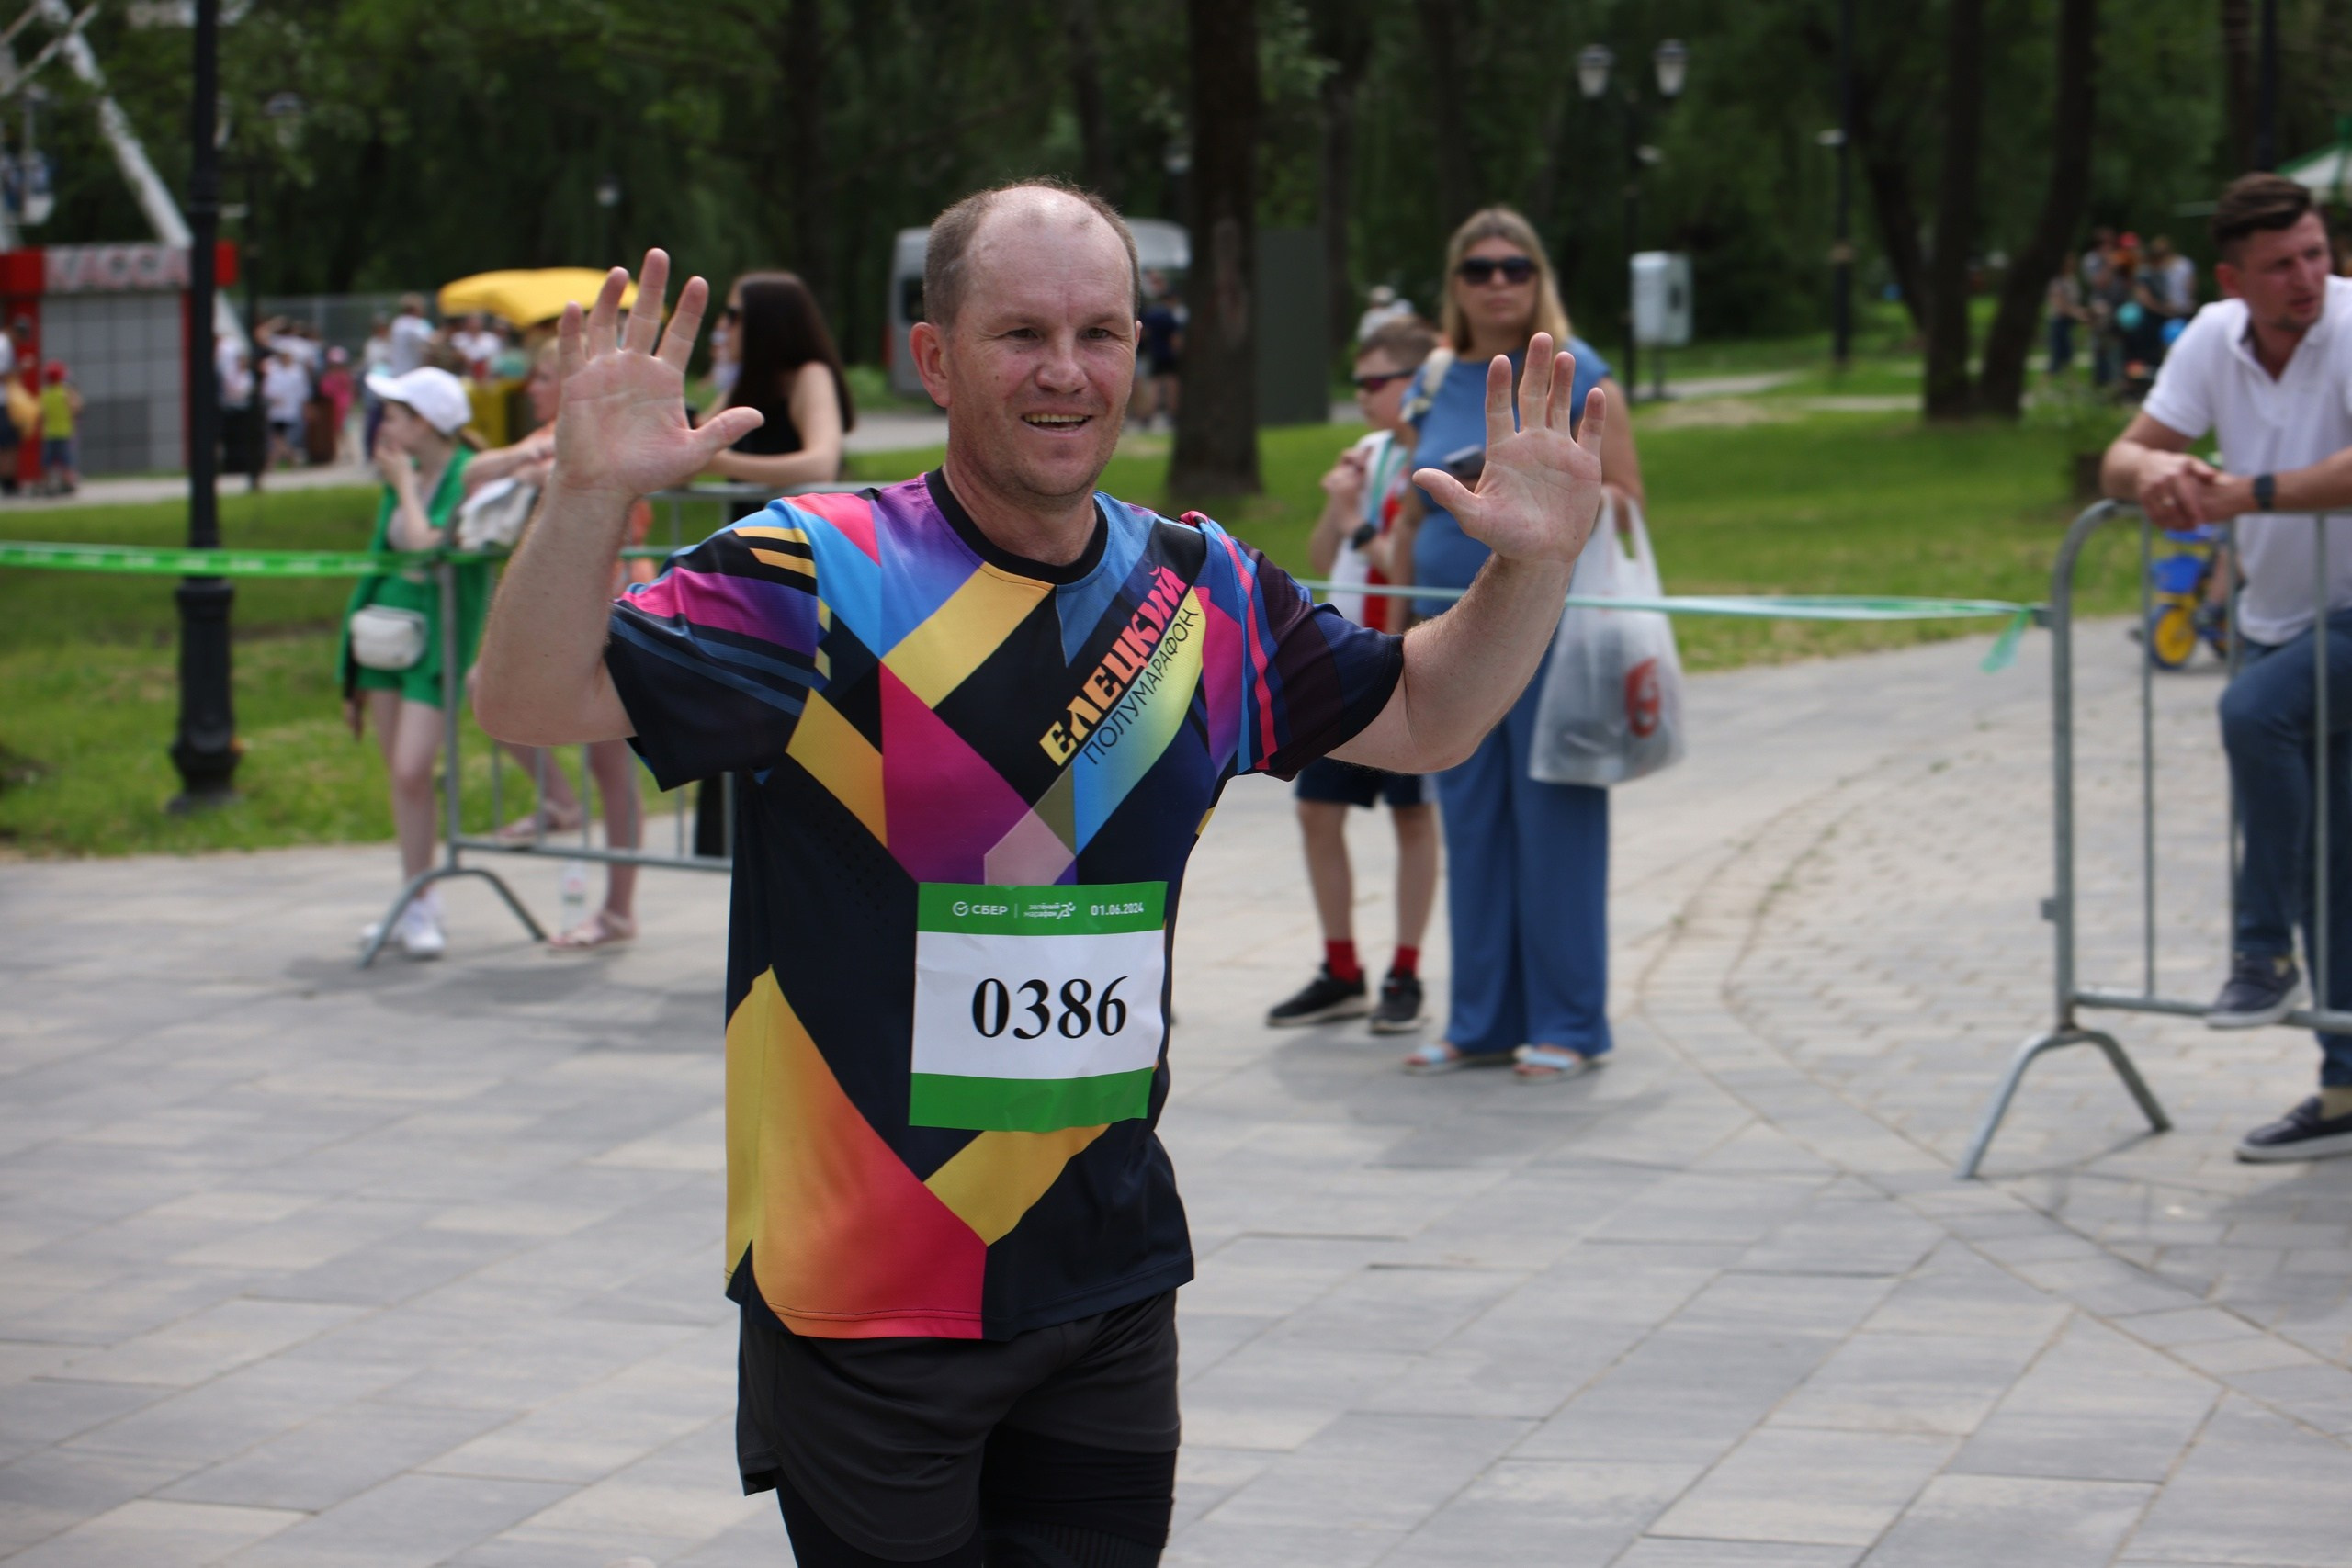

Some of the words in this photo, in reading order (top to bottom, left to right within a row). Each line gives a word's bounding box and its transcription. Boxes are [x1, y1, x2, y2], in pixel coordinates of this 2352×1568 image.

[1038, 565, 1188, 766] ЕЛЕЦКИЙ
[1082, 608, 1199, 765] ПОЛУМАРАФОН
[971, 905, 1008, 915] СБЕР
[1090, 902, 1145, 916] 01.06.2024
[972, 976, 1129, 1040] 0386
